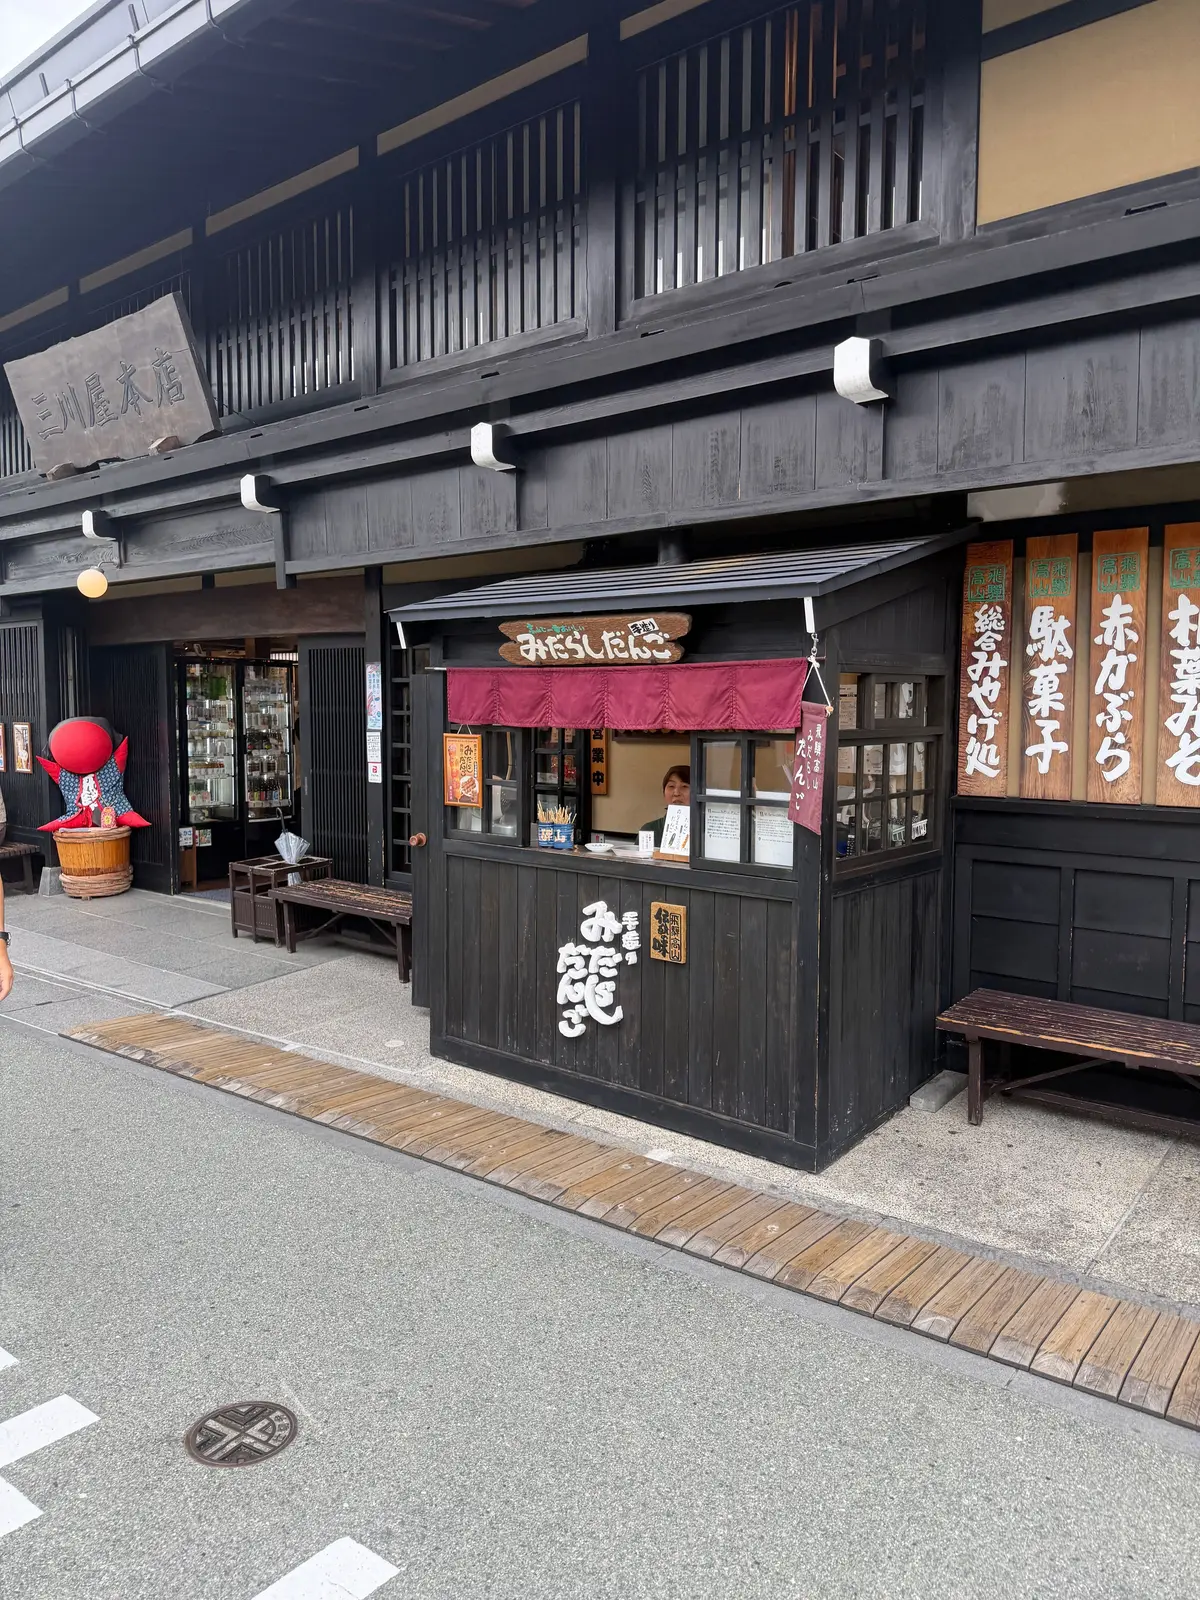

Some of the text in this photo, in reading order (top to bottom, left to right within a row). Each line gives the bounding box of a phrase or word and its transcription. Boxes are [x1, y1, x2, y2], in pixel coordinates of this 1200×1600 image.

[31, 347, 186, 440] 三川屋本店
[516, 630, 672, 662] みだらしだんご
[965, 604, 1008, 778] 総合みやげ処
[1025, 605, 1073, 775] 駄菓子
[1094, 593, 1139, 782] 赤かぶら
[591, 727, 605, 787] 営業中
